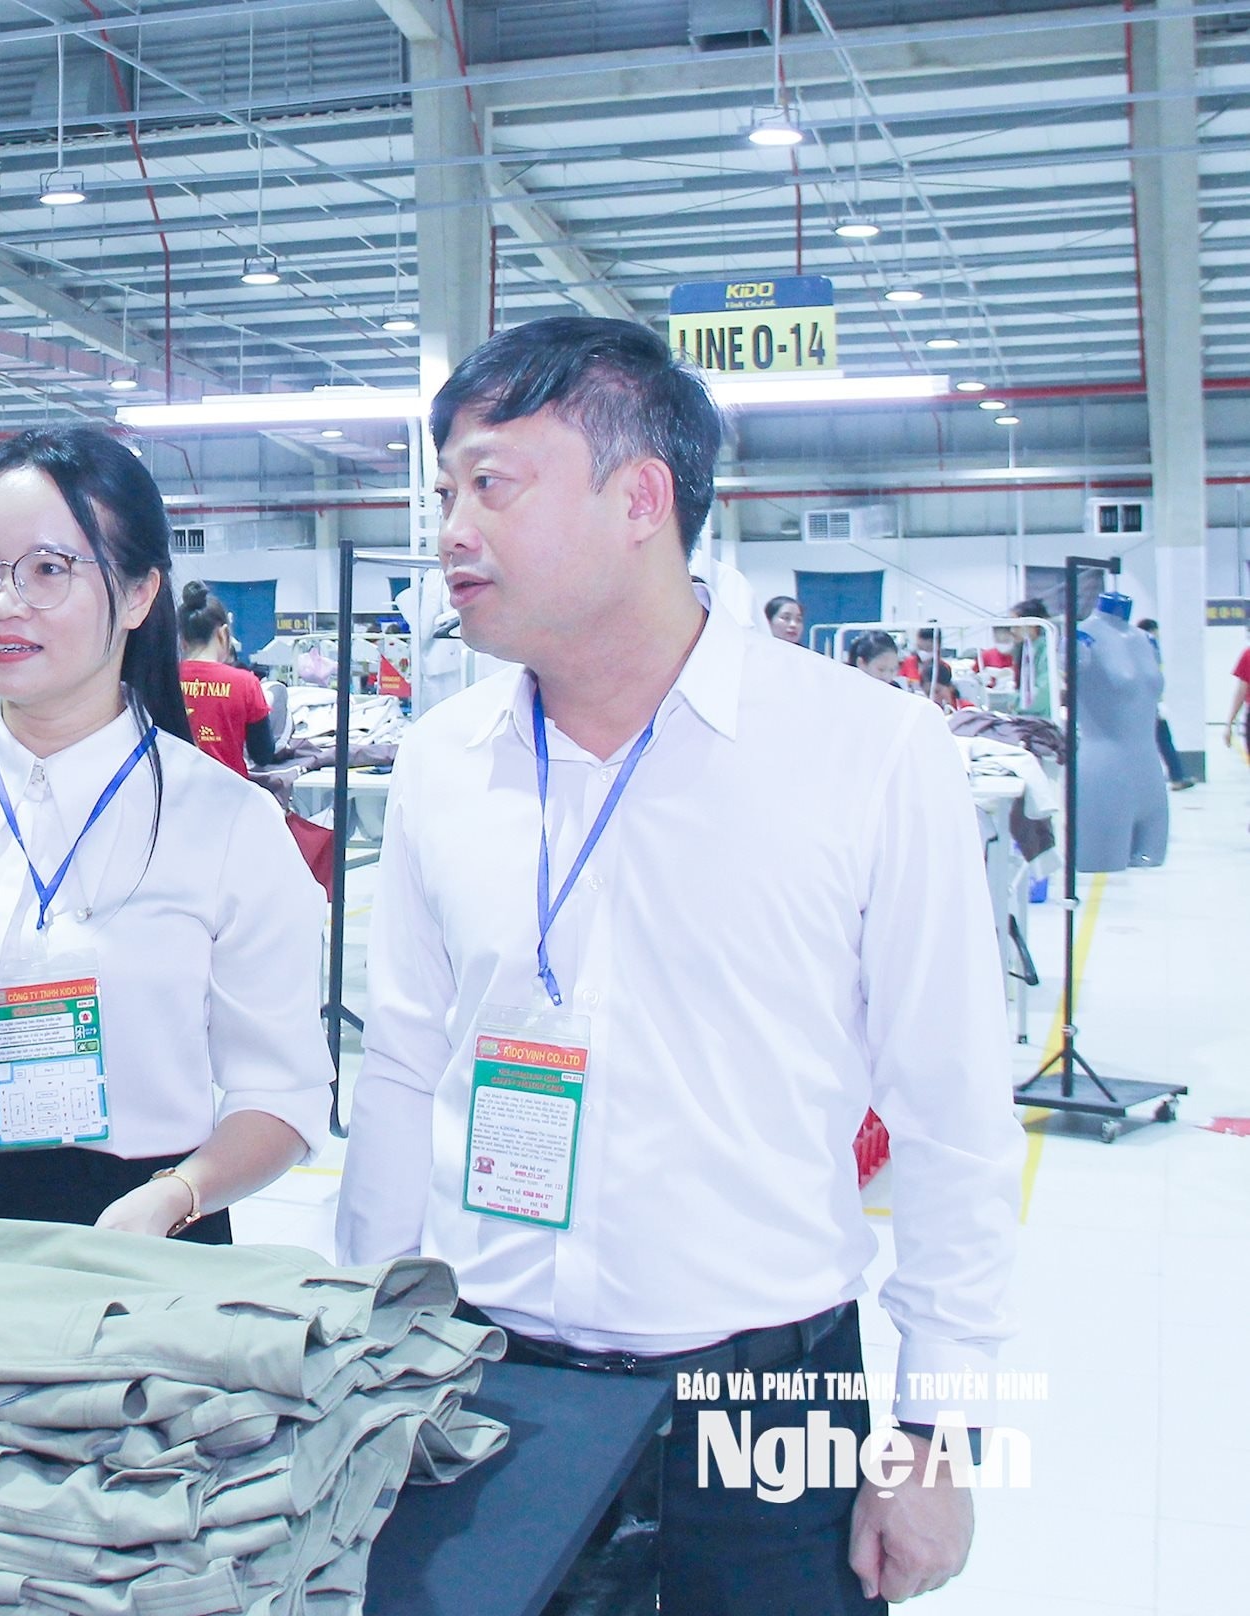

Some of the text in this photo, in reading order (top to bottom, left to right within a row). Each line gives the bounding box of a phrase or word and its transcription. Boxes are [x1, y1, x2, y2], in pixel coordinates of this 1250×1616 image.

[679, 326, 745, 370] LINE
[183, 678, 231, 698] VIỆT NAM
[7, 984, 95, 1002] CÔNG TY TNHH KIDO VINH
[503, 1046, 524, 1059] KIDO
[525, 1050, 545, 1062] VINH
